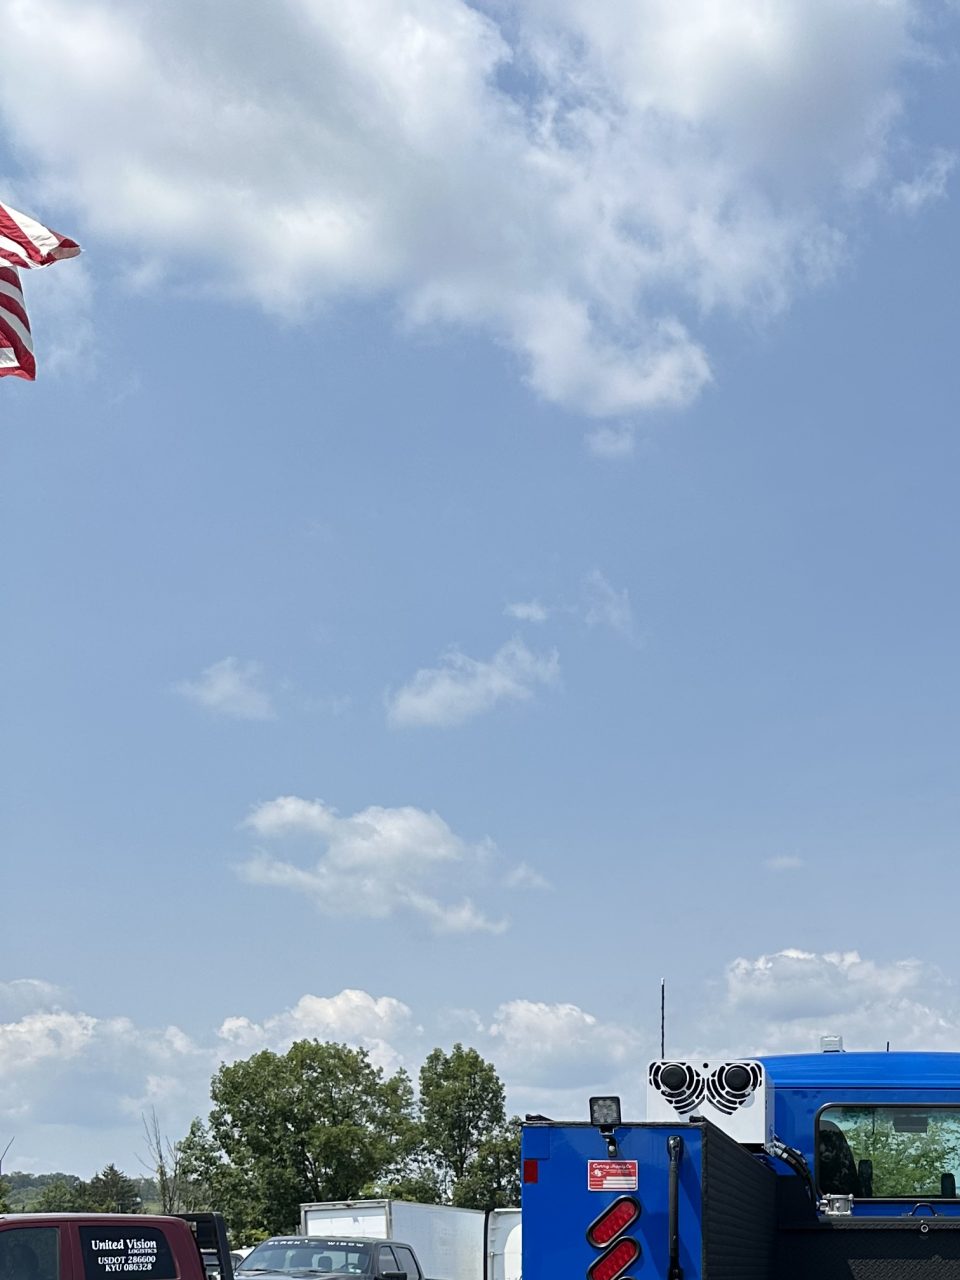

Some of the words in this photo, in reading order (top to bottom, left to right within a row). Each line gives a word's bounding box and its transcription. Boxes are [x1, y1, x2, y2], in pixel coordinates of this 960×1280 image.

[91, 1239, 124, 1250] United
[126, 1238, 157, 1249] Vision
[98, 1256, 126, 1264] USDOT
[127, 1255, 156, 1263] 286600
[105, 1263, 122, 1272] KYU
[123, 1262, 152, 1271] 086328
